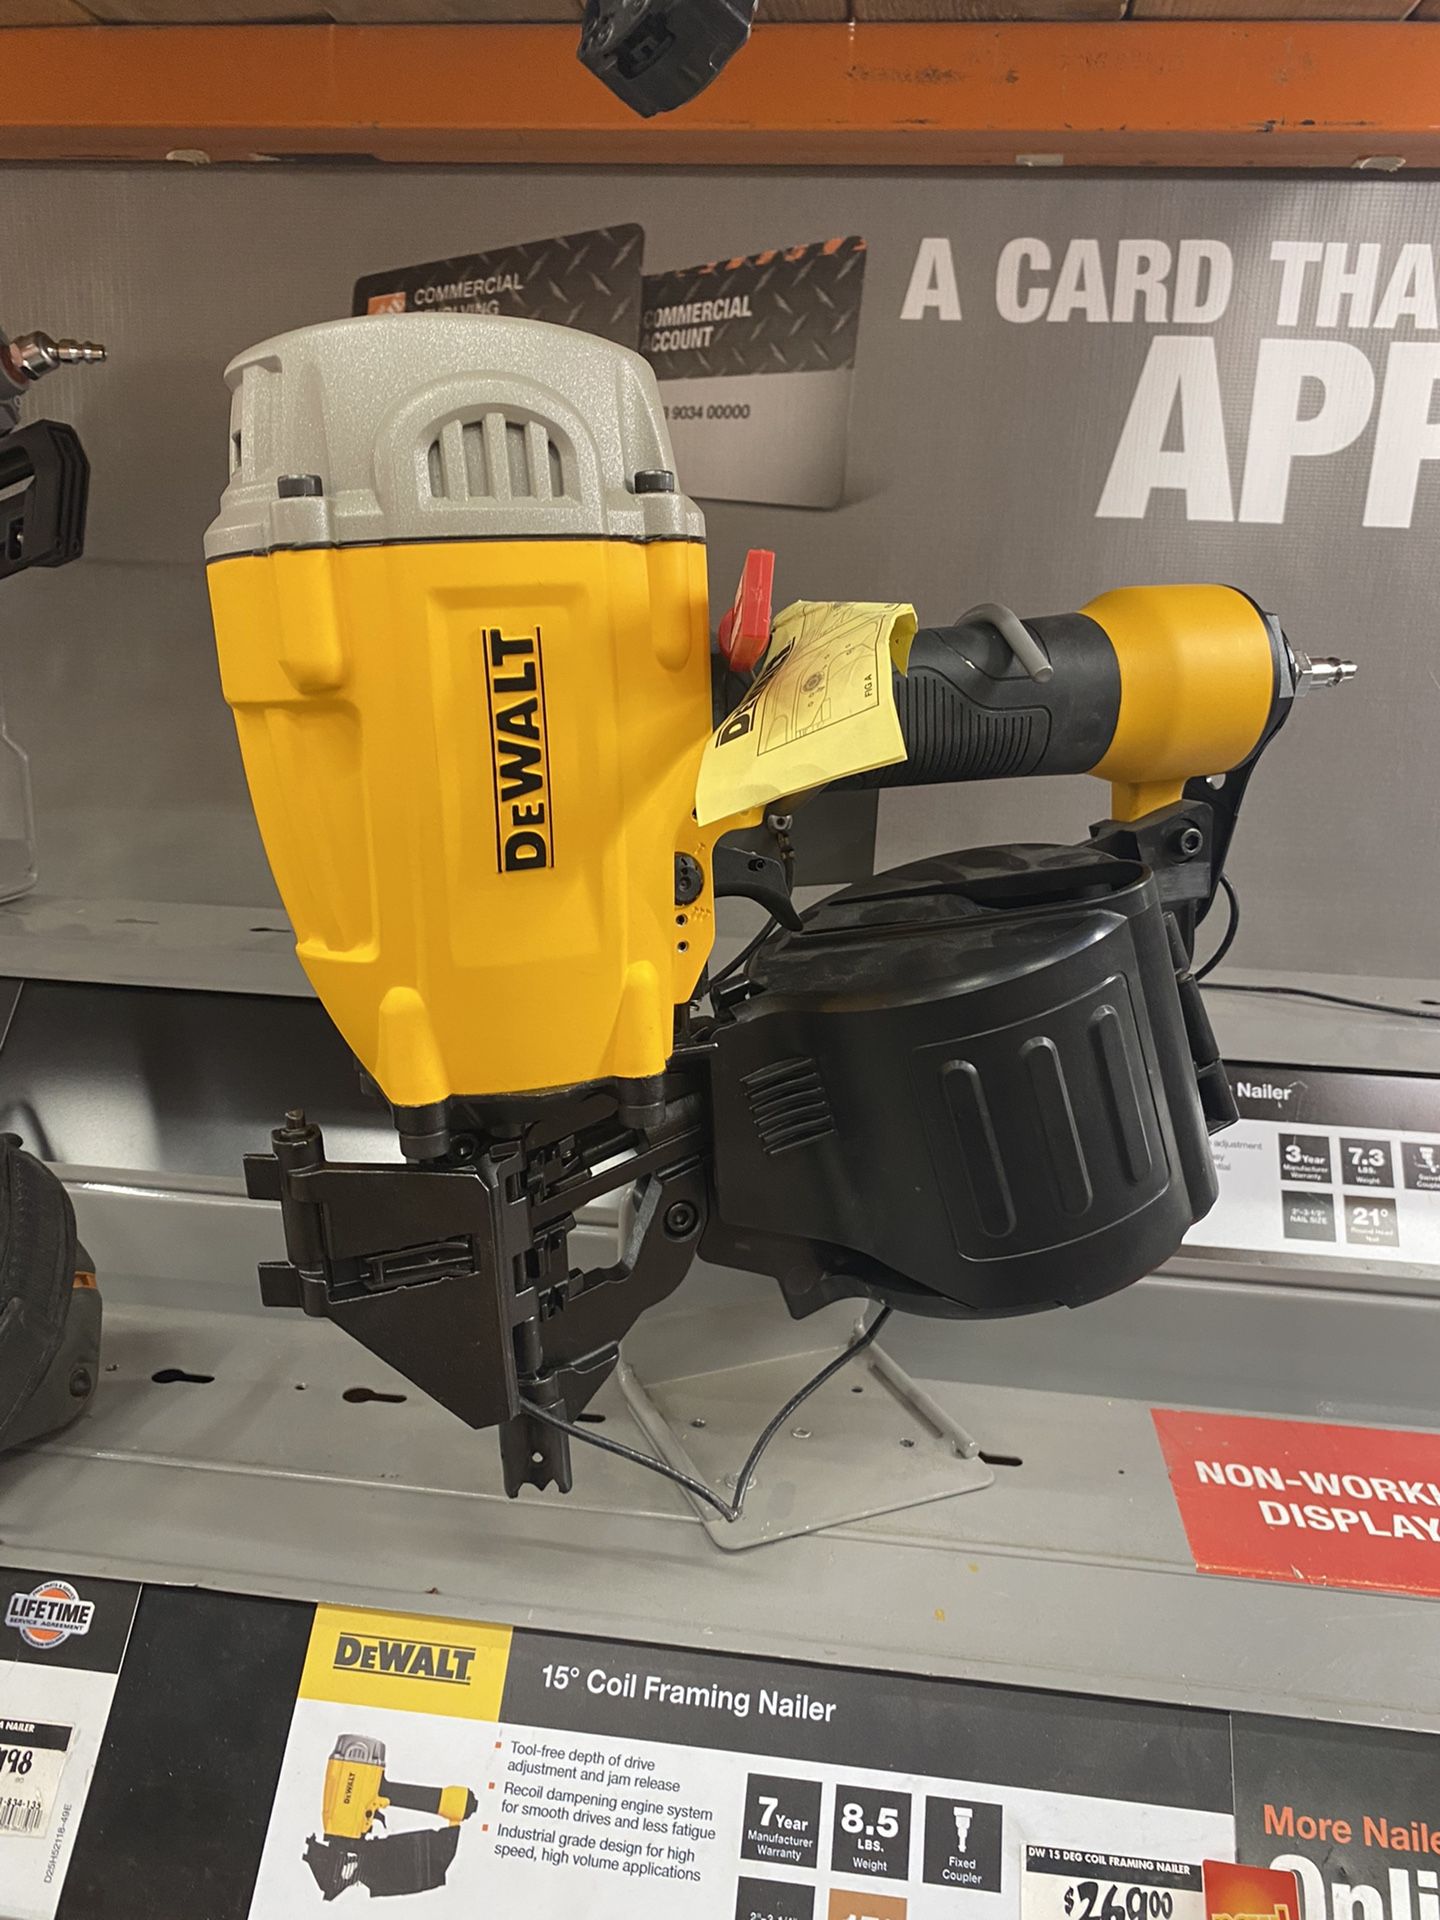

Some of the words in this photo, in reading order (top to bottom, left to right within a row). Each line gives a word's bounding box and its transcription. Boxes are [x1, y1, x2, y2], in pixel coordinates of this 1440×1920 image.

[414, 273, 524, 305] COMMERCIAL
[900, 238, 962, 320] A
[996, 238, 1234, 323] CARD
[1270, 241, 1440, 328] THA
[1237, 1082, 1292, 1100] Nailer
[1285, 1145, 1301, 1163] 3
[1302, 1154, 1326, 1165] Year
[1348, 1147, 1386, 1167] 7.3
[1258, 1500, 1440, 1543] DISPLAY
[10, 1598, 91, 1624] LIFETIME
[41, 1620, 85, 1631] AGREEMENT
[541, 1664, 580, 1689] 15°
[587, 1669, 637, 1699] Coil
[643, 1676, 750, 1716] Framing
[758, 1688, 837, 1723] Nailer
[5, 1722, 35, 1733] NAILER
[510, 1740, 566, 1760] Tool-free
[568, 1748, 604, 1766] depth
[608, 1752, 621, 1767] of
[624, 1755, 656, 1771] drive
[507, 1760, 577, 1780] adjustment
[580, 1766, 605, 1783] and
[606, 1770, 631, 1788] jam
[634, 1774, 681, 1792] release
[504, 1781, 543, 1798] Recoil
[546, 1786, 617, 1811] dampening
[621, 1798, 664, 1815] engine
[667, 1804, 713, 1821] system
[758, 1795, 779, 1826] 7
[775, 1813, 809, 1831] Year
[501, 1800, 518, 1814] for
[521, 1803, 569, 1821] smooth
[572, 1809, 611, 1827] drives
[614, 1814, 639, 1830] and
[642, 1818, 668, 1834] less
[671, 1821, 716, 1841] fatigue
[840, 1802, 900, 1838] 8.5
[1263, 1804, 1352, 1844] More
[497, 1823, 556, 1844] Industrial
[558, 1833, 596, 1850] grade
[599, 1837, 642, 1856] design
[645, 1842, 664, 1857] for
[667, 1844, 695, 1864] high
[747, 1830, 814, 1849] Manufacturer
[756, 1844, 802, 1861] Warranty
[856, 1838, 884, 1852] LBS.
[494, 1842, 537, 1861] speed,
[541, 1848, 569, 1867] high
[572, 1854, 619, 1871] volume
[622, 1859, 701, 1882] applications
[852, 1856, 888, 1872] Weight
[948, 1855, 976, 1870] Fixed
[1028, 1846, 1046, 1858] DW
[1049, 1849, 1060, 1860] 15
[1063, 1851, 1082, 1862] DEG
[1084, 1853, 1107, 1866] COIL
[1109, 1857, 1154, 1871] FRAMING
[1156, 1864, 1191, 1875] NAILER
[942, 1869, 982, 1885] Coupler
